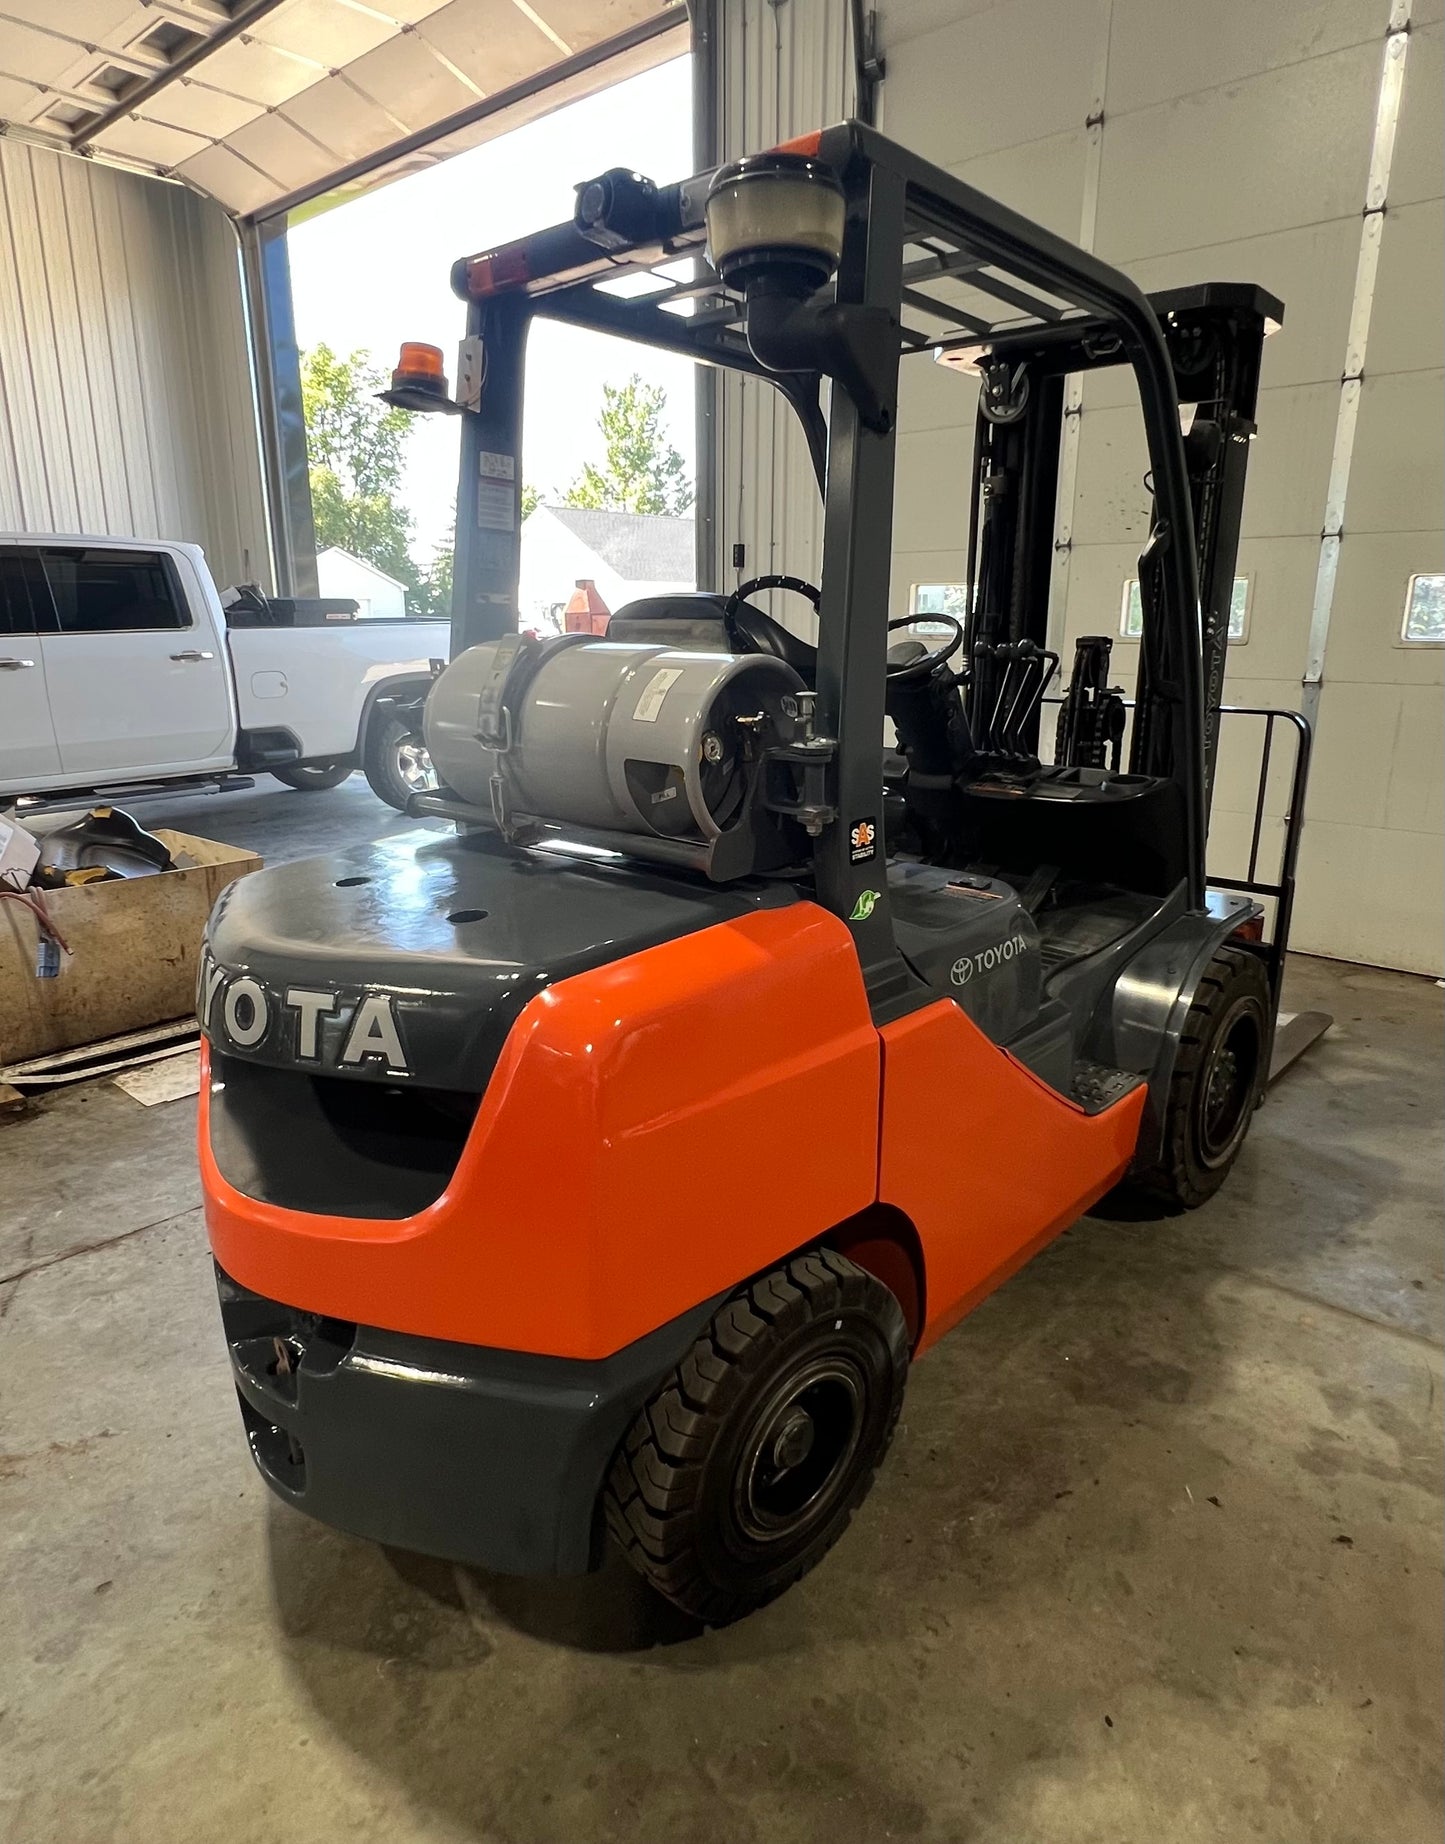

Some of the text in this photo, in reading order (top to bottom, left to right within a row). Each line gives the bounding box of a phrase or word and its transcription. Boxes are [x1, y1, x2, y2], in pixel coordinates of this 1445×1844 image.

[851, 822, 875, 847] SAS
[974, 934, 1027, 973] TOYOTA
[203, 960, 408, 1068] YOTA
